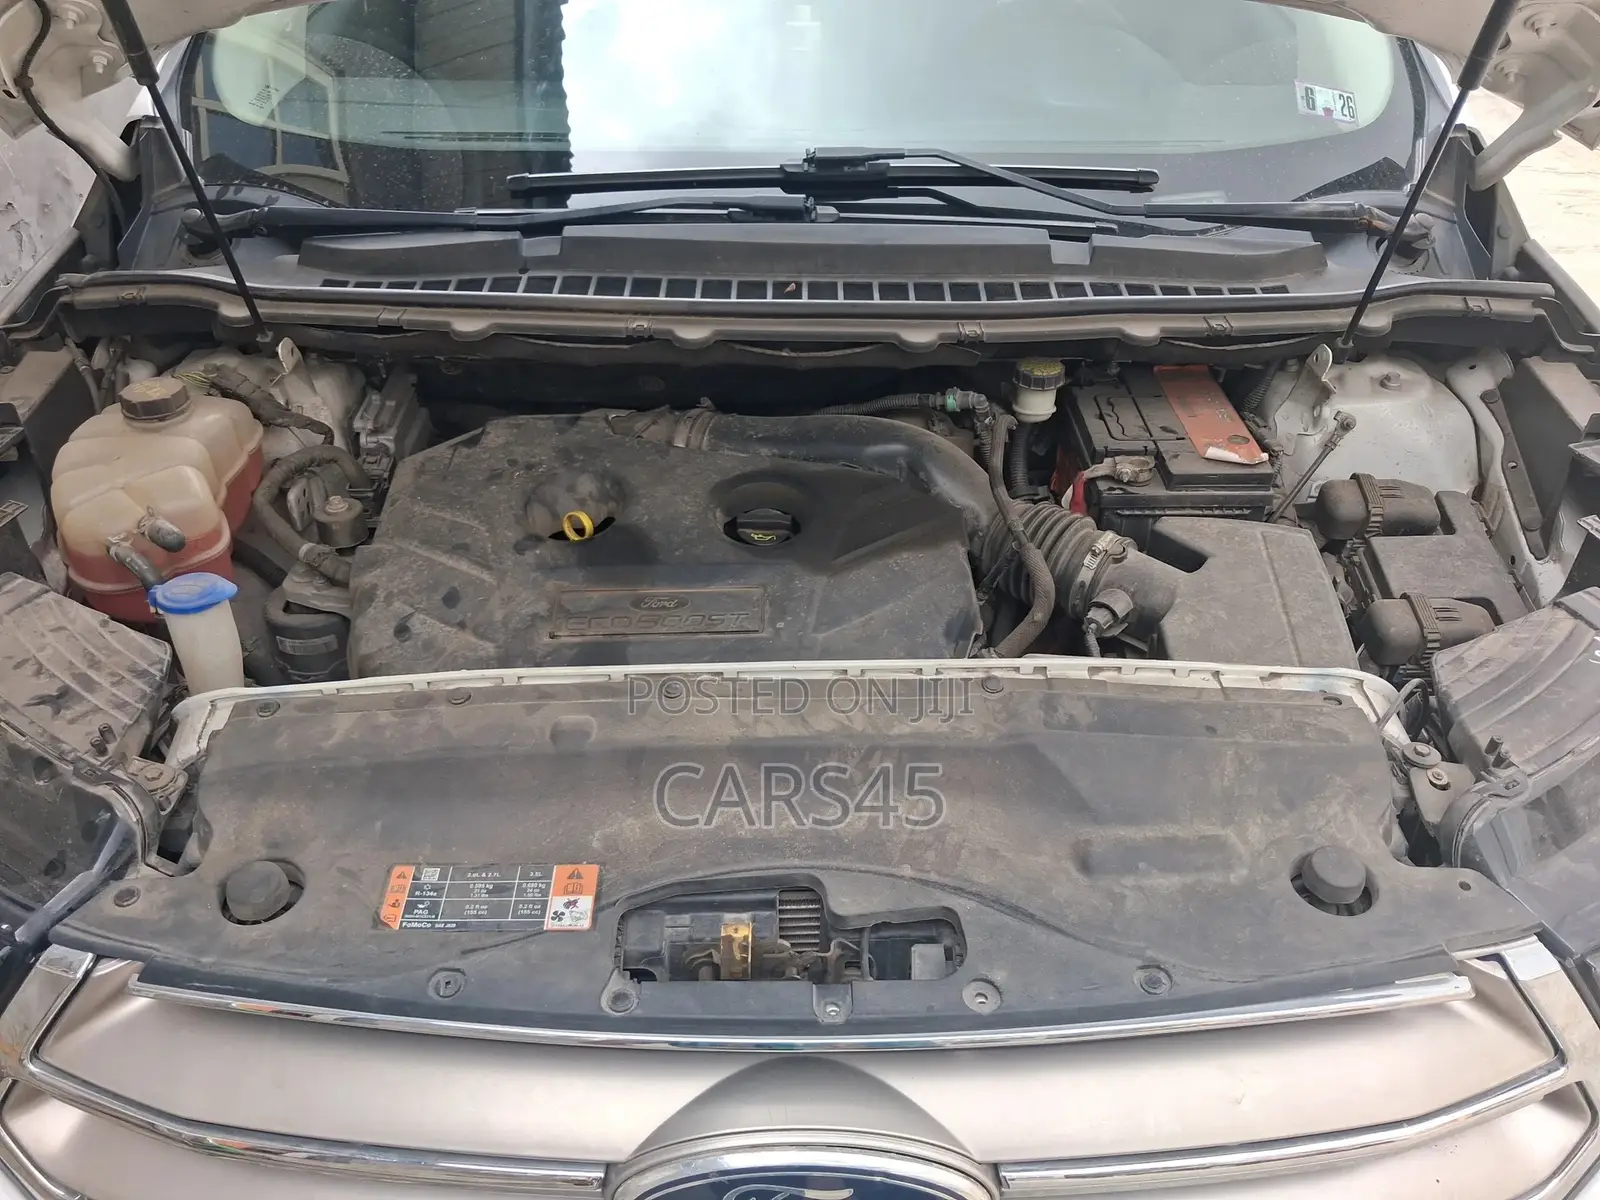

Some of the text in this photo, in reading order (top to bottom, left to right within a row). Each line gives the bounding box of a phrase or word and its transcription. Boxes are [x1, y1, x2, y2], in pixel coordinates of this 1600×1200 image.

[1304, 86, 1316, 111] 6
[1338, 93, 1355, 119] 26
[640, 596, 677, 609] Ford
